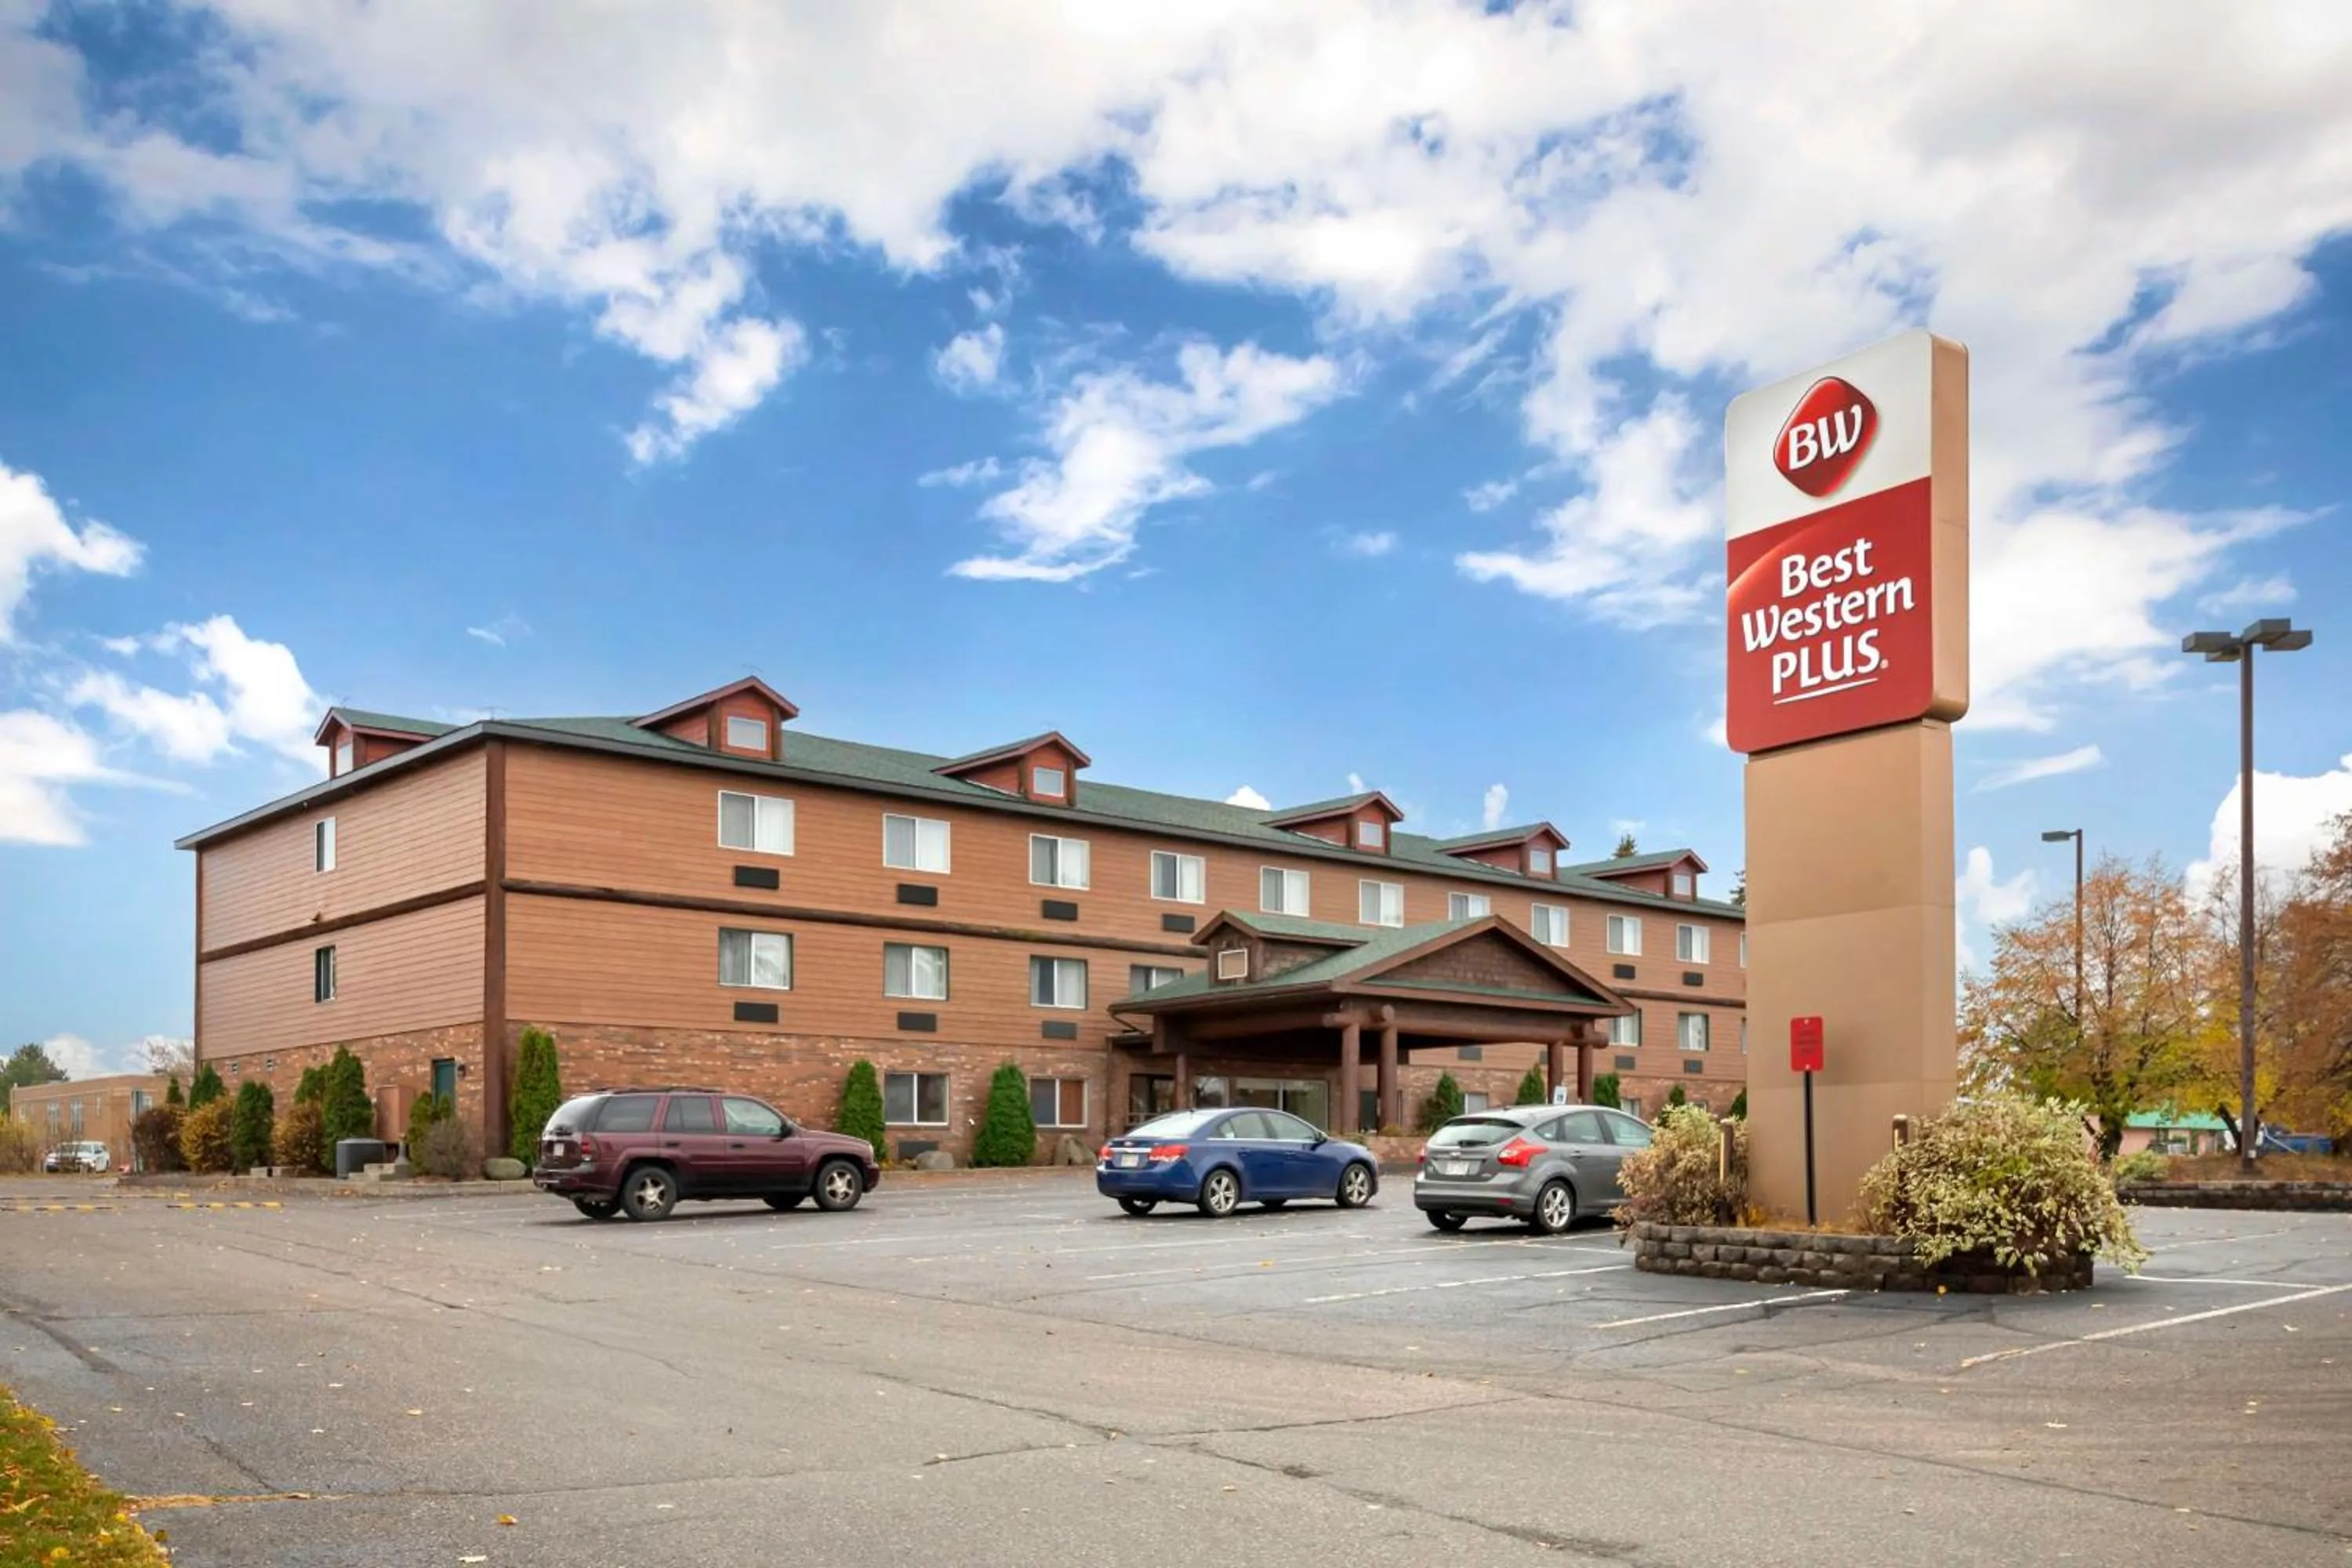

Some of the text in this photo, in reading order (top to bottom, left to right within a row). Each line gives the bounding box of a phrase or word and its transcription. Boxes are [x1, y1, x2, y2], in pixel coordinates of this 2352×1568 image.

[1788, 404, 1862, 470] BW
[1781, 538, 1874, 598] Best
[1741, 576, 1915, 653] Western
